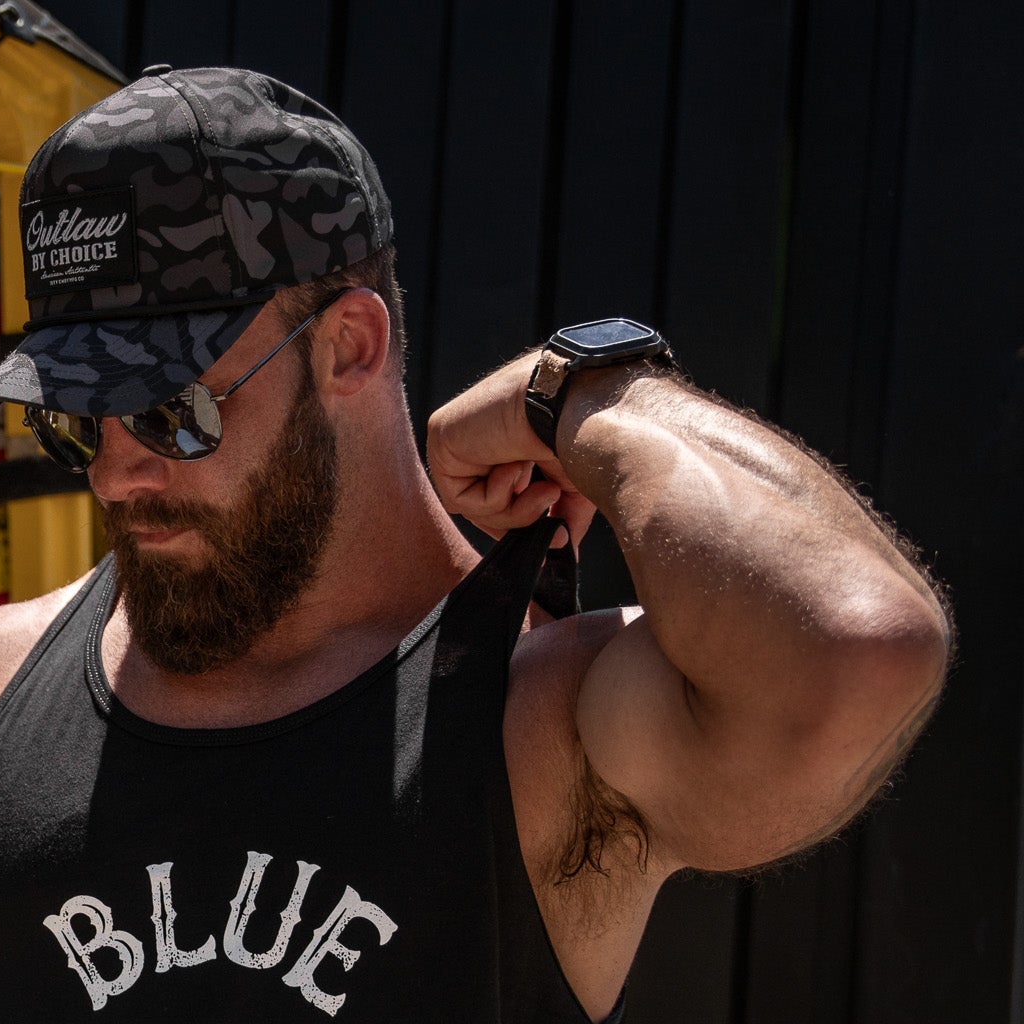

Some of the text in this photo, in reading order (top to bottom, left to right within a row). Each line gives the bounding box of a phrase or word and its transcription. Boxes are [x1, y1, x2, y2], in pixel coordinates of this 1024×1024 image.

[27, 207, 127, 251] Outlaw
[32, 241, 117, 271] BY CHOICE
[43, 851, 398, 1017] BLUE
